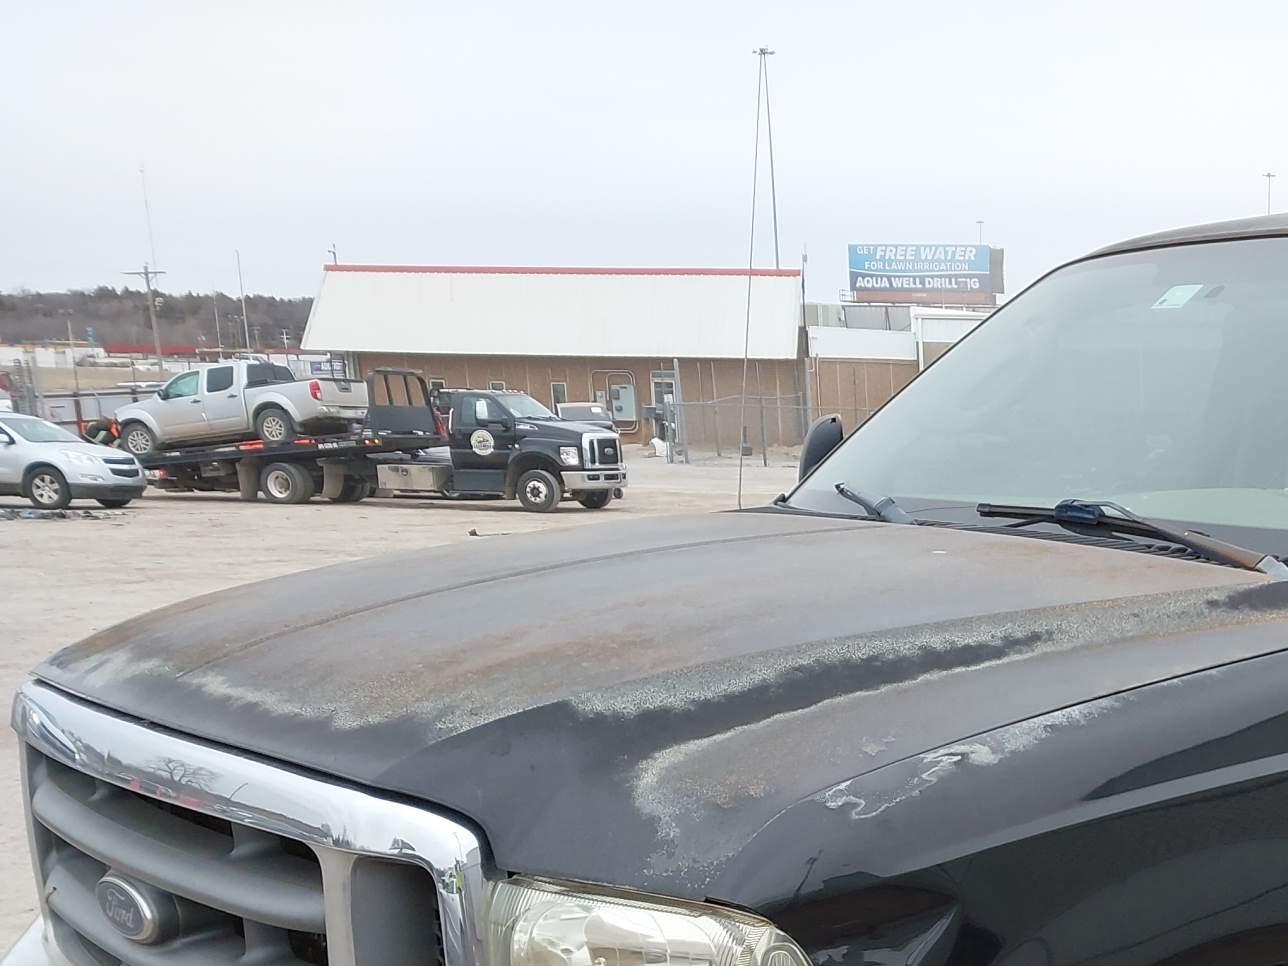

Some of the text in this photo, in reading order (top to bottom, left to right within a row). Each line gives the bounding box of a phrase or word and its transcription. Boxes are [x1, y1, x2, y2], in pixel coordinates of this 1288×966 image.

[857, 246, 976, 261] GET FREE WATER
[864, 261, 969, 271] FOR LAWN IRRIGATION
[856, 277, 980, 289] AQUA WELL DRILLG
[106, 888, 135, 929] Ford
